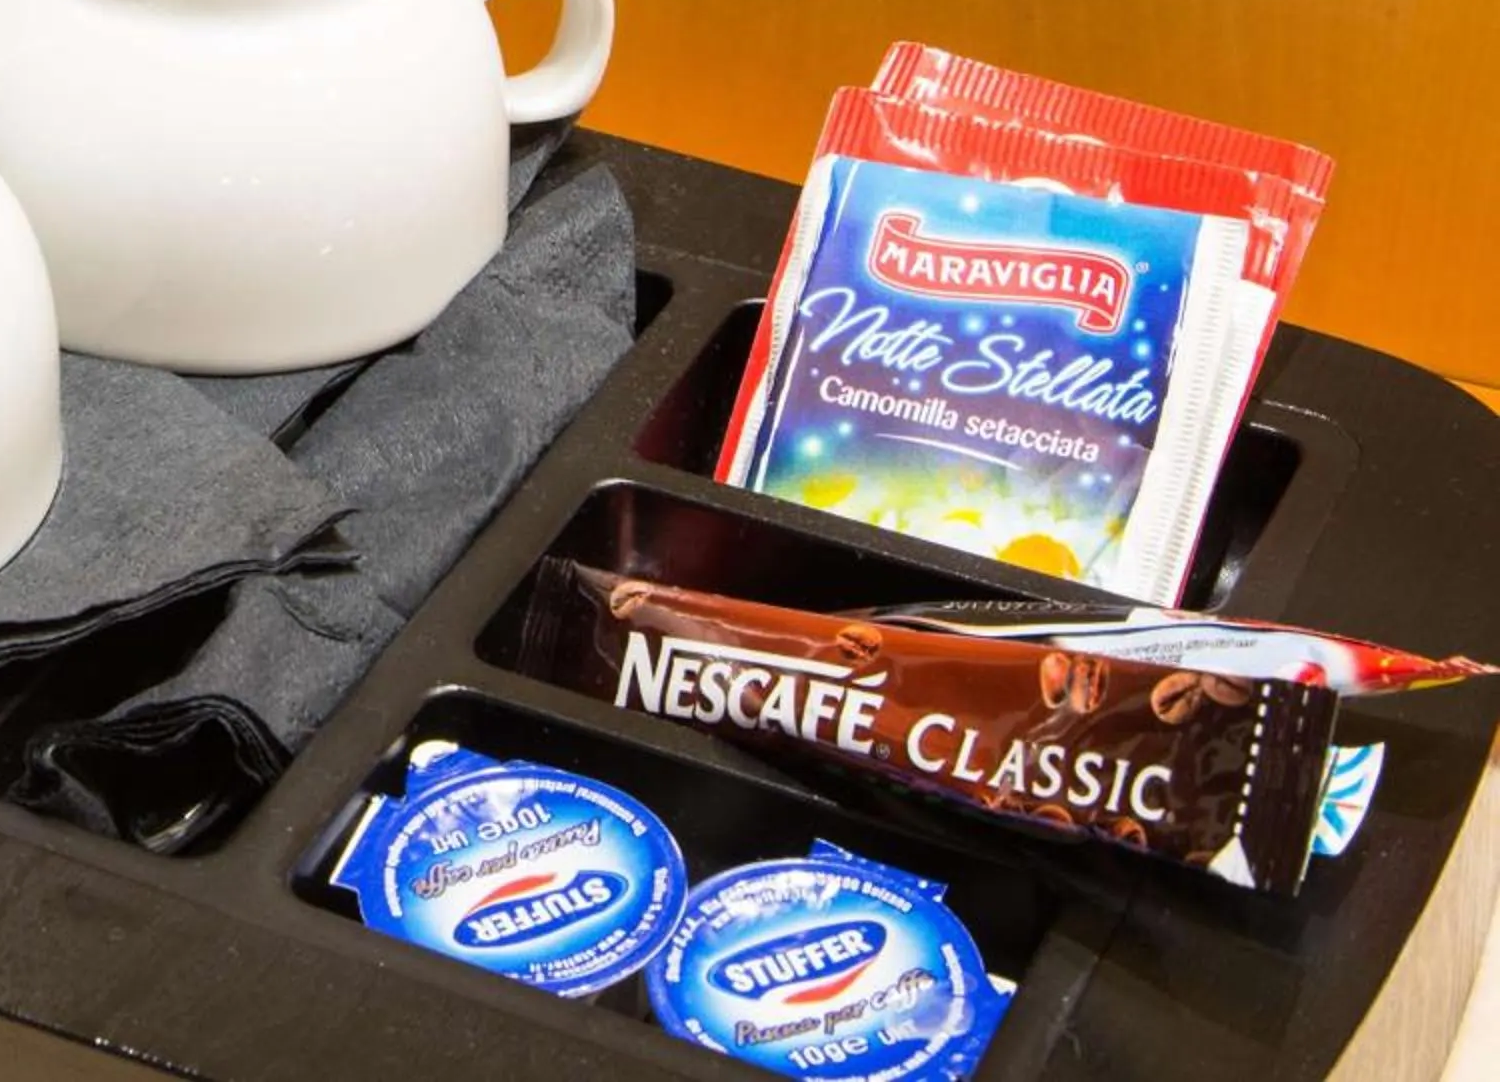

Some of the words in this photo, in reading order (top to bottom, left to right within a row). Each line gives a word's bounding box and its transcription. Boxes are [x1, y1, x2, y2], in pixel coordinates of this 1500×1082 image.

[880, 241, 1119, 306] MARAVIGLIA
[799, 286, 954, 368] Notte
[940, 334, 1156, 423] Stellata
[819, 374, 959, 432] Camomilla
[963, 414, 1100, 463] setacciata
[613, 630, 888, 757] NESCAFÉ
[906, 712, 1173, 822] CLASSIC
[430, 829, 470, 856] UHT
[475, 840, 520, 878] per
[467, 877, 612, 942] STUFFER
[724, 929, 873, 994] STUFFER
[734, 1015, 821, 1048] Panna
[824, 997, 869, 1035] per
